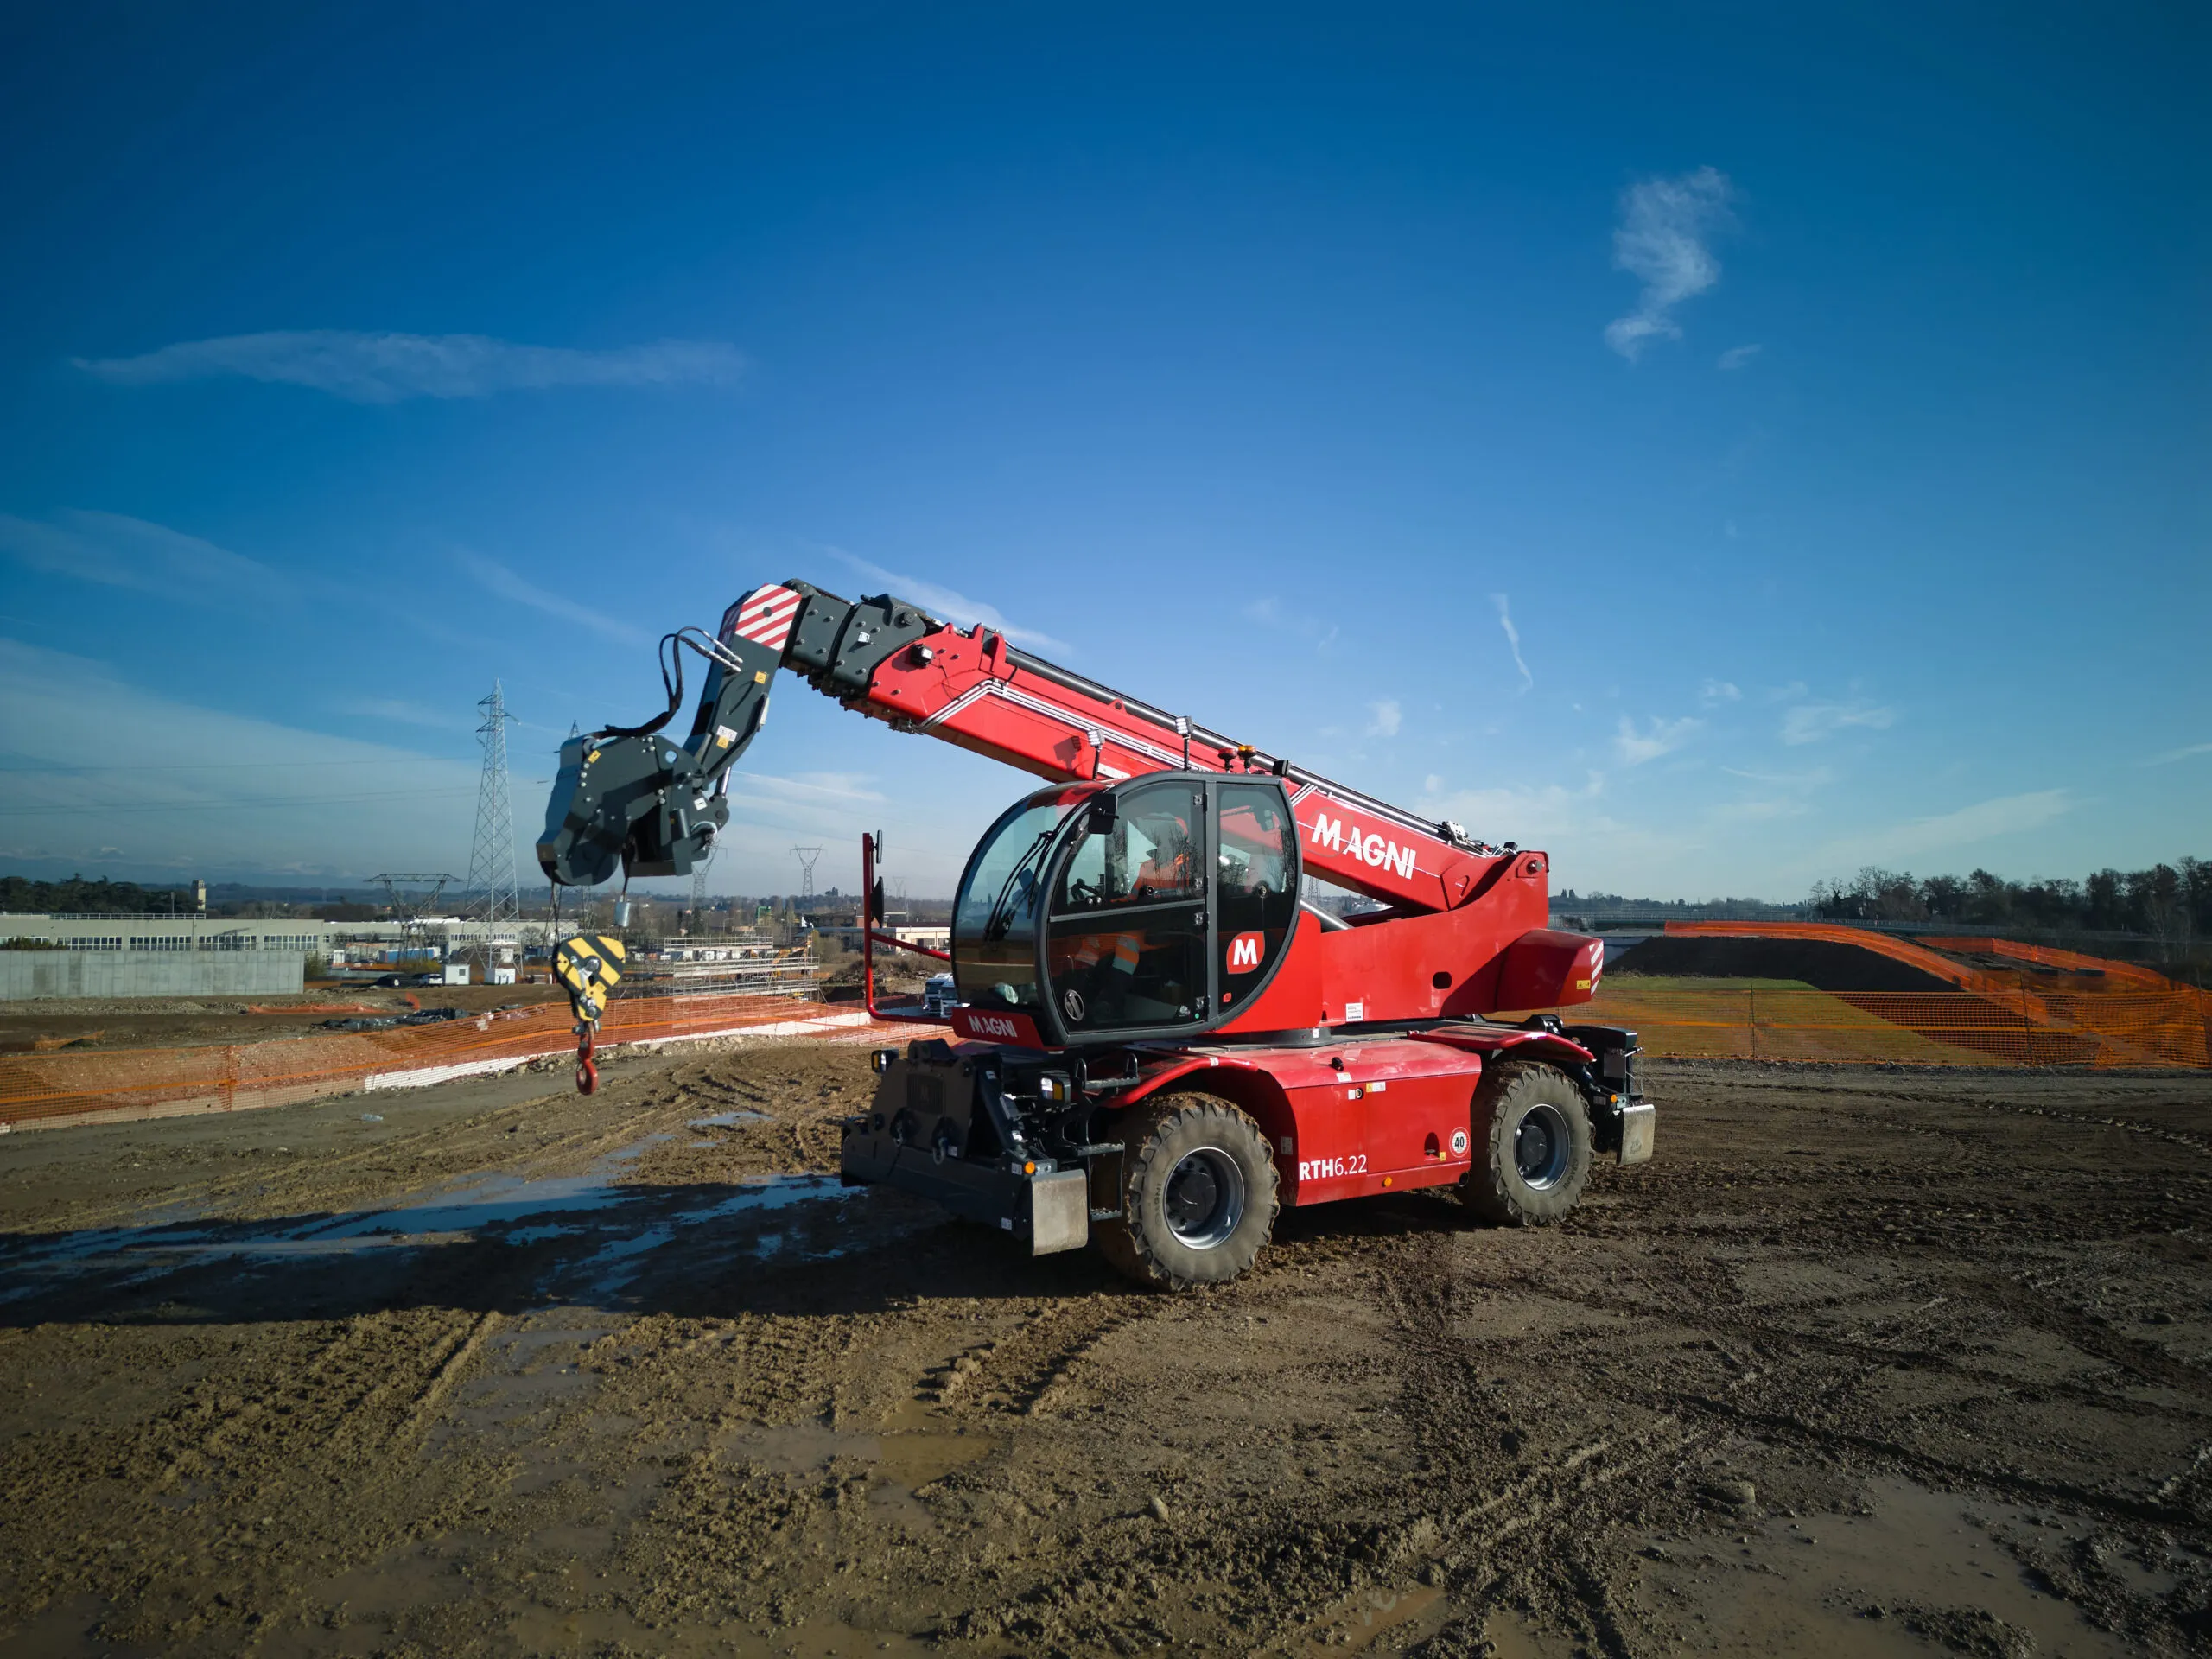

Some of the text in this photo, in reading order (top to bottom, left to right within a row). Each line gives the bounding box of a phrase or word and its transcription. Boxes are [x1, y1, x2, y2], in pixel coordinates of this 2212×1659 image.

[1312, 813, 1416, 880] MAGNI
[1233, 939, 1258, 965] M
[968, 1015, 1018, 1038] MAGNI
[1454, 1136, 1465, 1148] 40
[1299, 1154, 1367, 1181] RTH6.22
